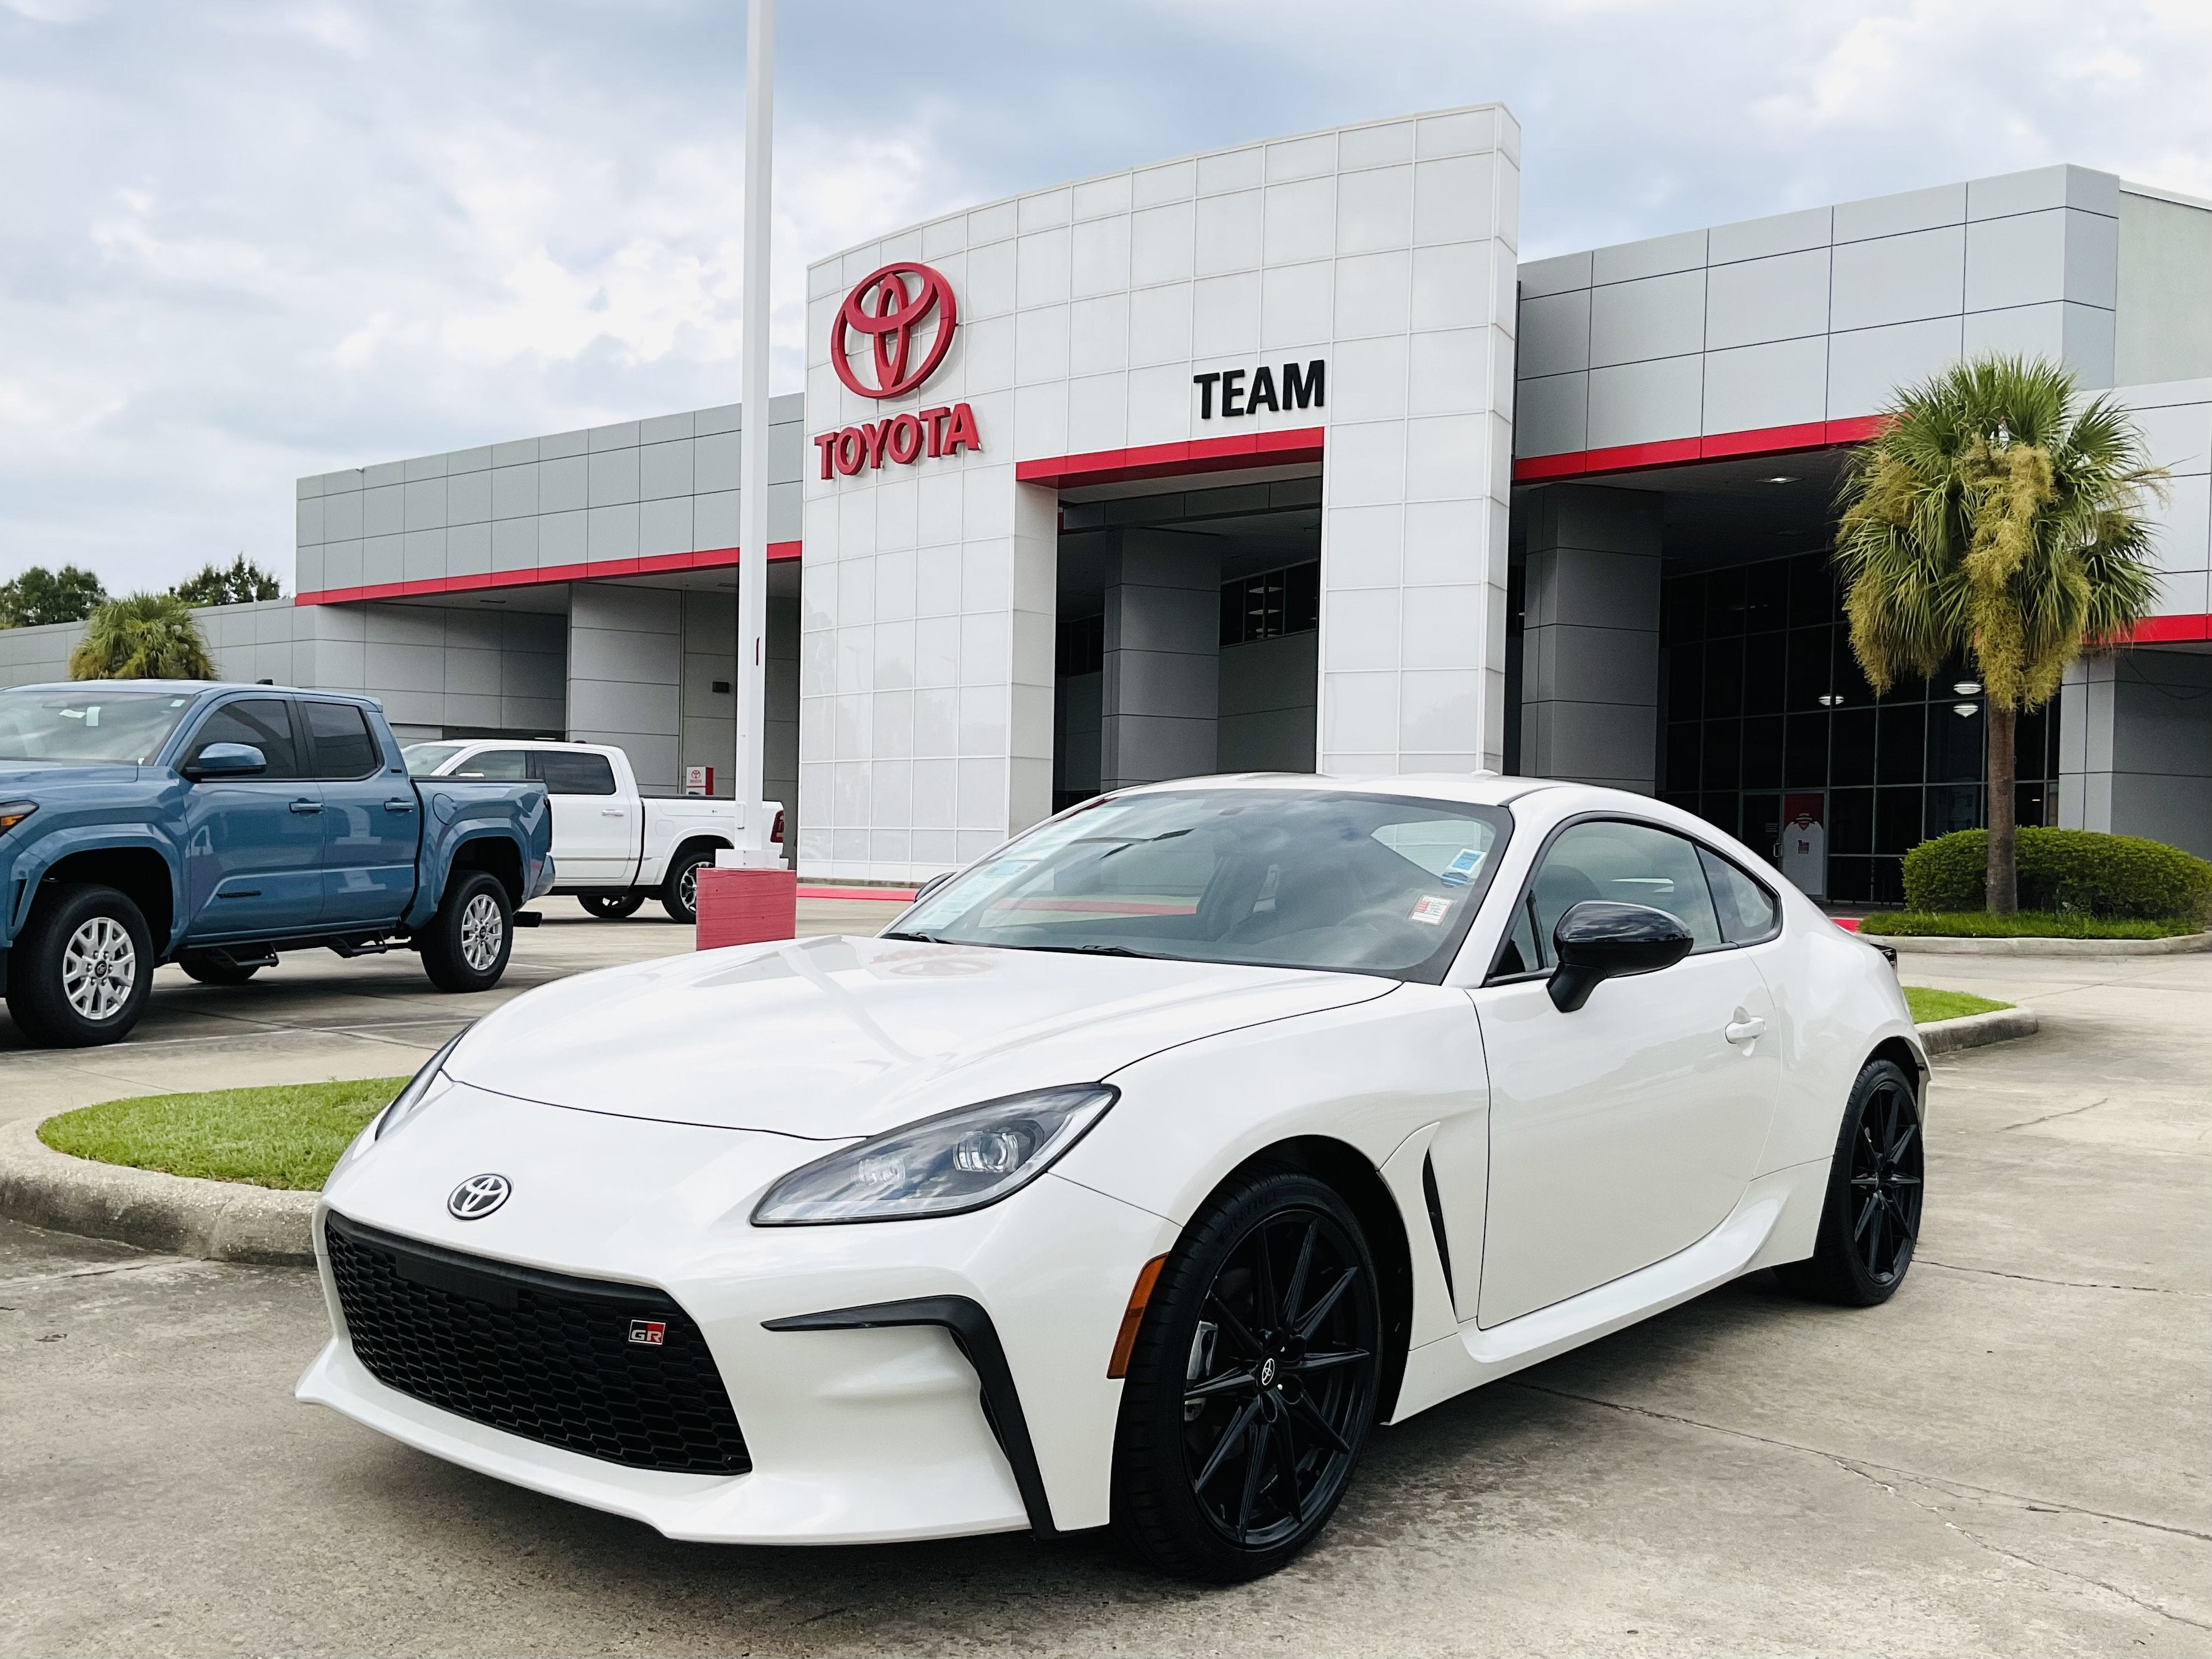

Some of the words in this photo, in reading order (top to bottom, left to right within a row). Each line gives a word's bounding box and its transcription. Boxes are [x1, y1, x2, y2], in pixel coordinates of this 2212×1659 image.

[1194, 359, 1324, 419] TEAM
[814, 402, 980, 480] TOYOTA
[631, 1330, 662, 1342] GR
